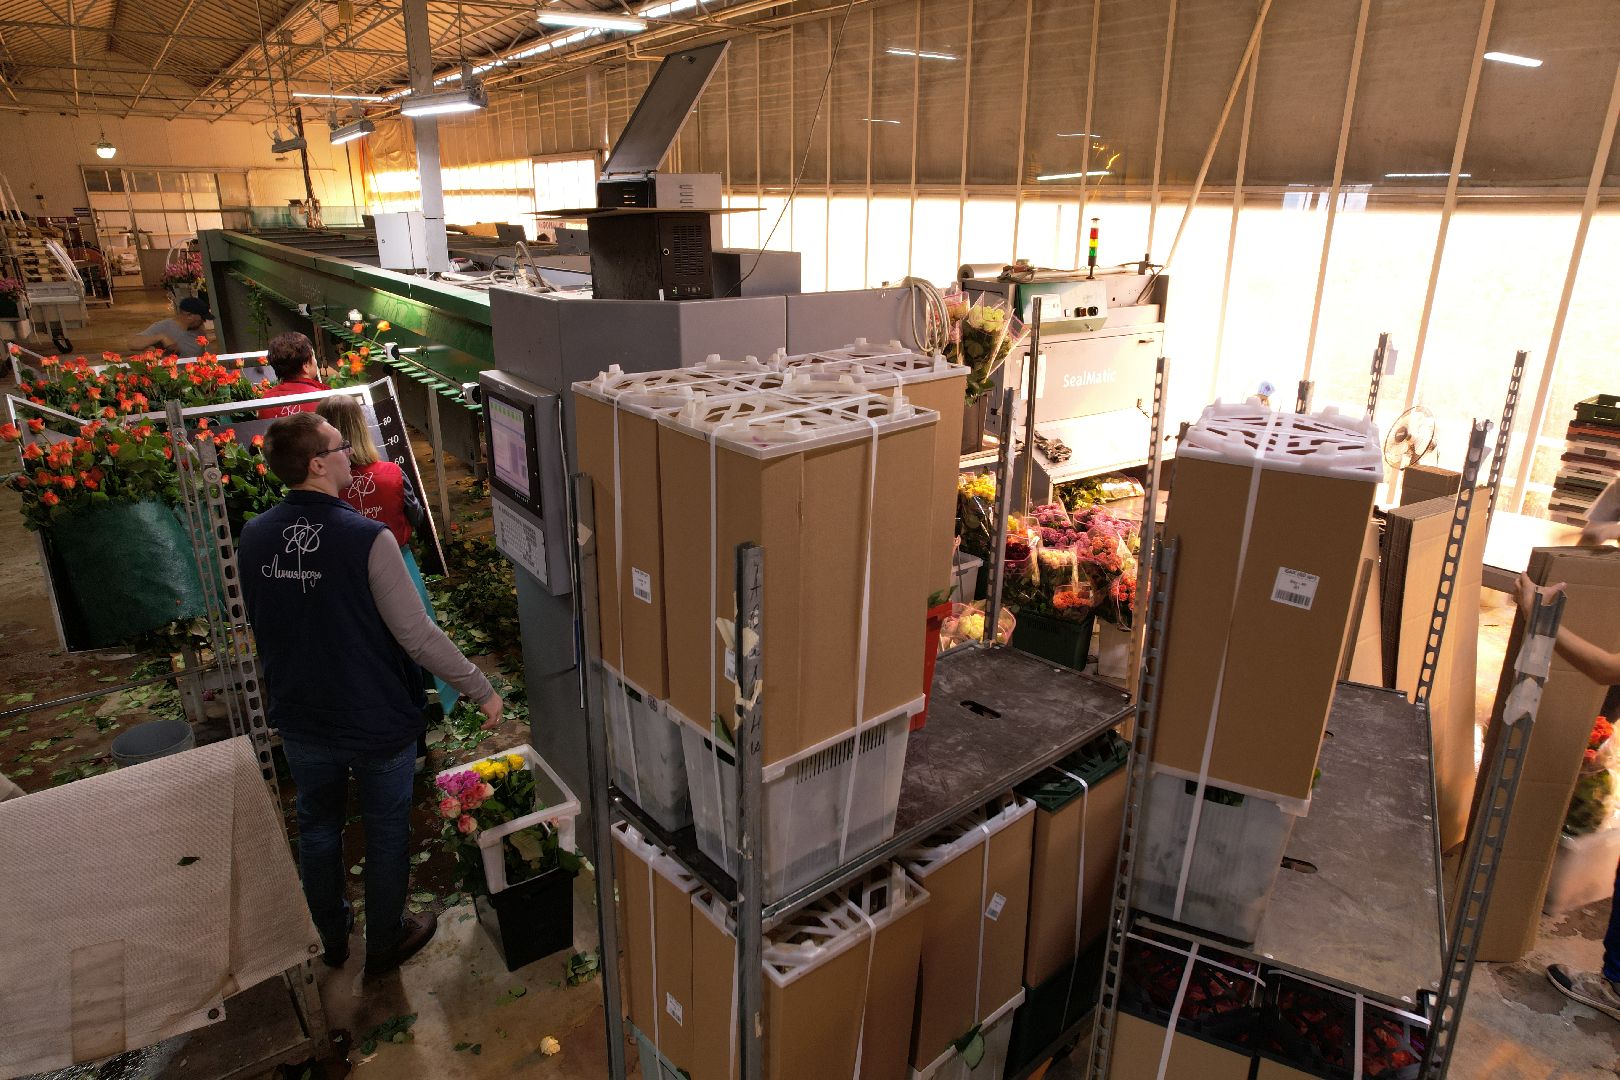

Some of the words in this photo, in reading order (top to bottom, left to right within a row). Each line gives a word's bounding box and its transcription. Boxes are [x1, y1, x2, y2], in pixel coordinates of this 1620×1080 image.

[1063, 368, 1117, 388] SealMatic
[383, 416, 392, 426] 80
[388, 435, 399, 446] 70
[394, 456, 405, 466] 60
